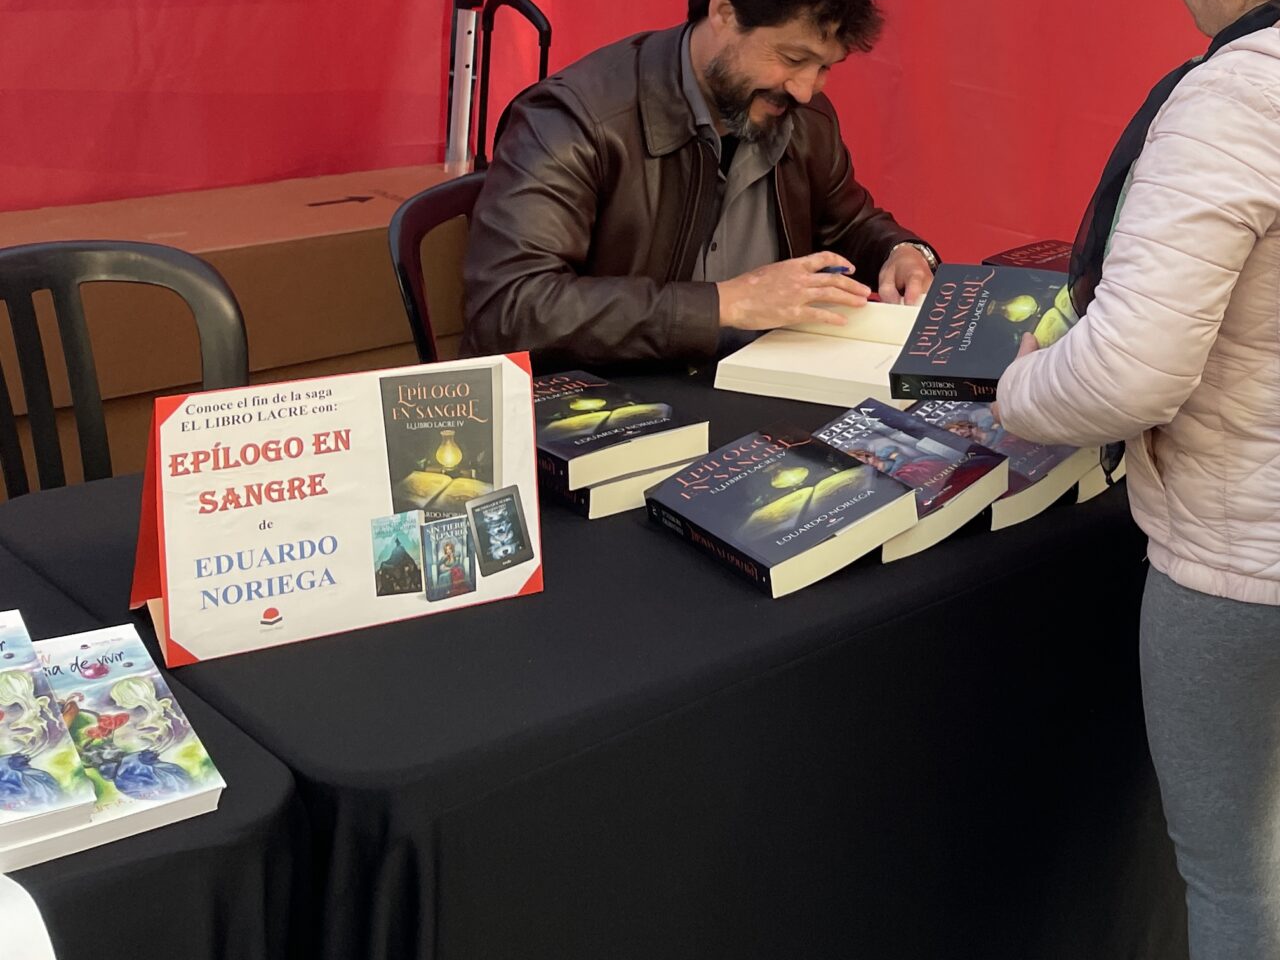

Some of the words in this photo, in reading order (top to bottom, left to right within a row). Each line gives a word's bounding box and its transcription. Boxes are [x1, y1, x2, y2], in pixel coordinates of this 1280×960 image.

[908, 282, 957, 357] EPÍLOGO
[932, 346, 953, 365] EN
[945, 269, 995, 340] SANGRE
[971, 299, 987, 320] LACRE
[981, 290, 990, 298] IV
[398, 382, 470, 407] EPÍLOGO
[902, 382, 910, 392] IV
[920, 388, 957, 397] EDUARDO
[921, 380, 955, 388] NORIEGA
[181, 421, 201, 432] EL
[205, 413, 253, 429] LIBRO
[257, 404, 308, 422] LACRE
[312, 403, 338, 415] con:
[185, 399, 234, 416] Conoce
[237, 397, 248, 409] el
[252, 395, 268, 407] fin
[272, 392, 287, 404] de
[290, 391, 301, 402] la
[305, 388, 332, 401] saga
[392, 407, 410, 420] EN
[416, 399, 489, 423] SANGRE
[818, 407, 876, 441] ERRA
[827, 416, 882, 453] TRIA
[168, 436, 304, 477] EPÍLOGO
[312, 429, 351, 455] EN
[676, 434, 773, 488] EPÍLOGO
[680, 484, 710, 501] EN
[714, 438, 813, 479] SANGRE
[747, 457, 777, 474] LACRE
[776, 451, 786, 459] IV
[923, 451, 977, 491] NORIEGA
[198, 473, 329, 514] SANGRE
[258, 520, 274, 531] de
[776, 514, 828, 546] EDUARDO
[828, 489, 876, 517] NORIEGA
[194, 535, 338, 579] EDUARDO
[200, 568, 337, 610] NORIEGA
[70, 655, 90, 674] de
[97, 650, 125, 667] vivir
